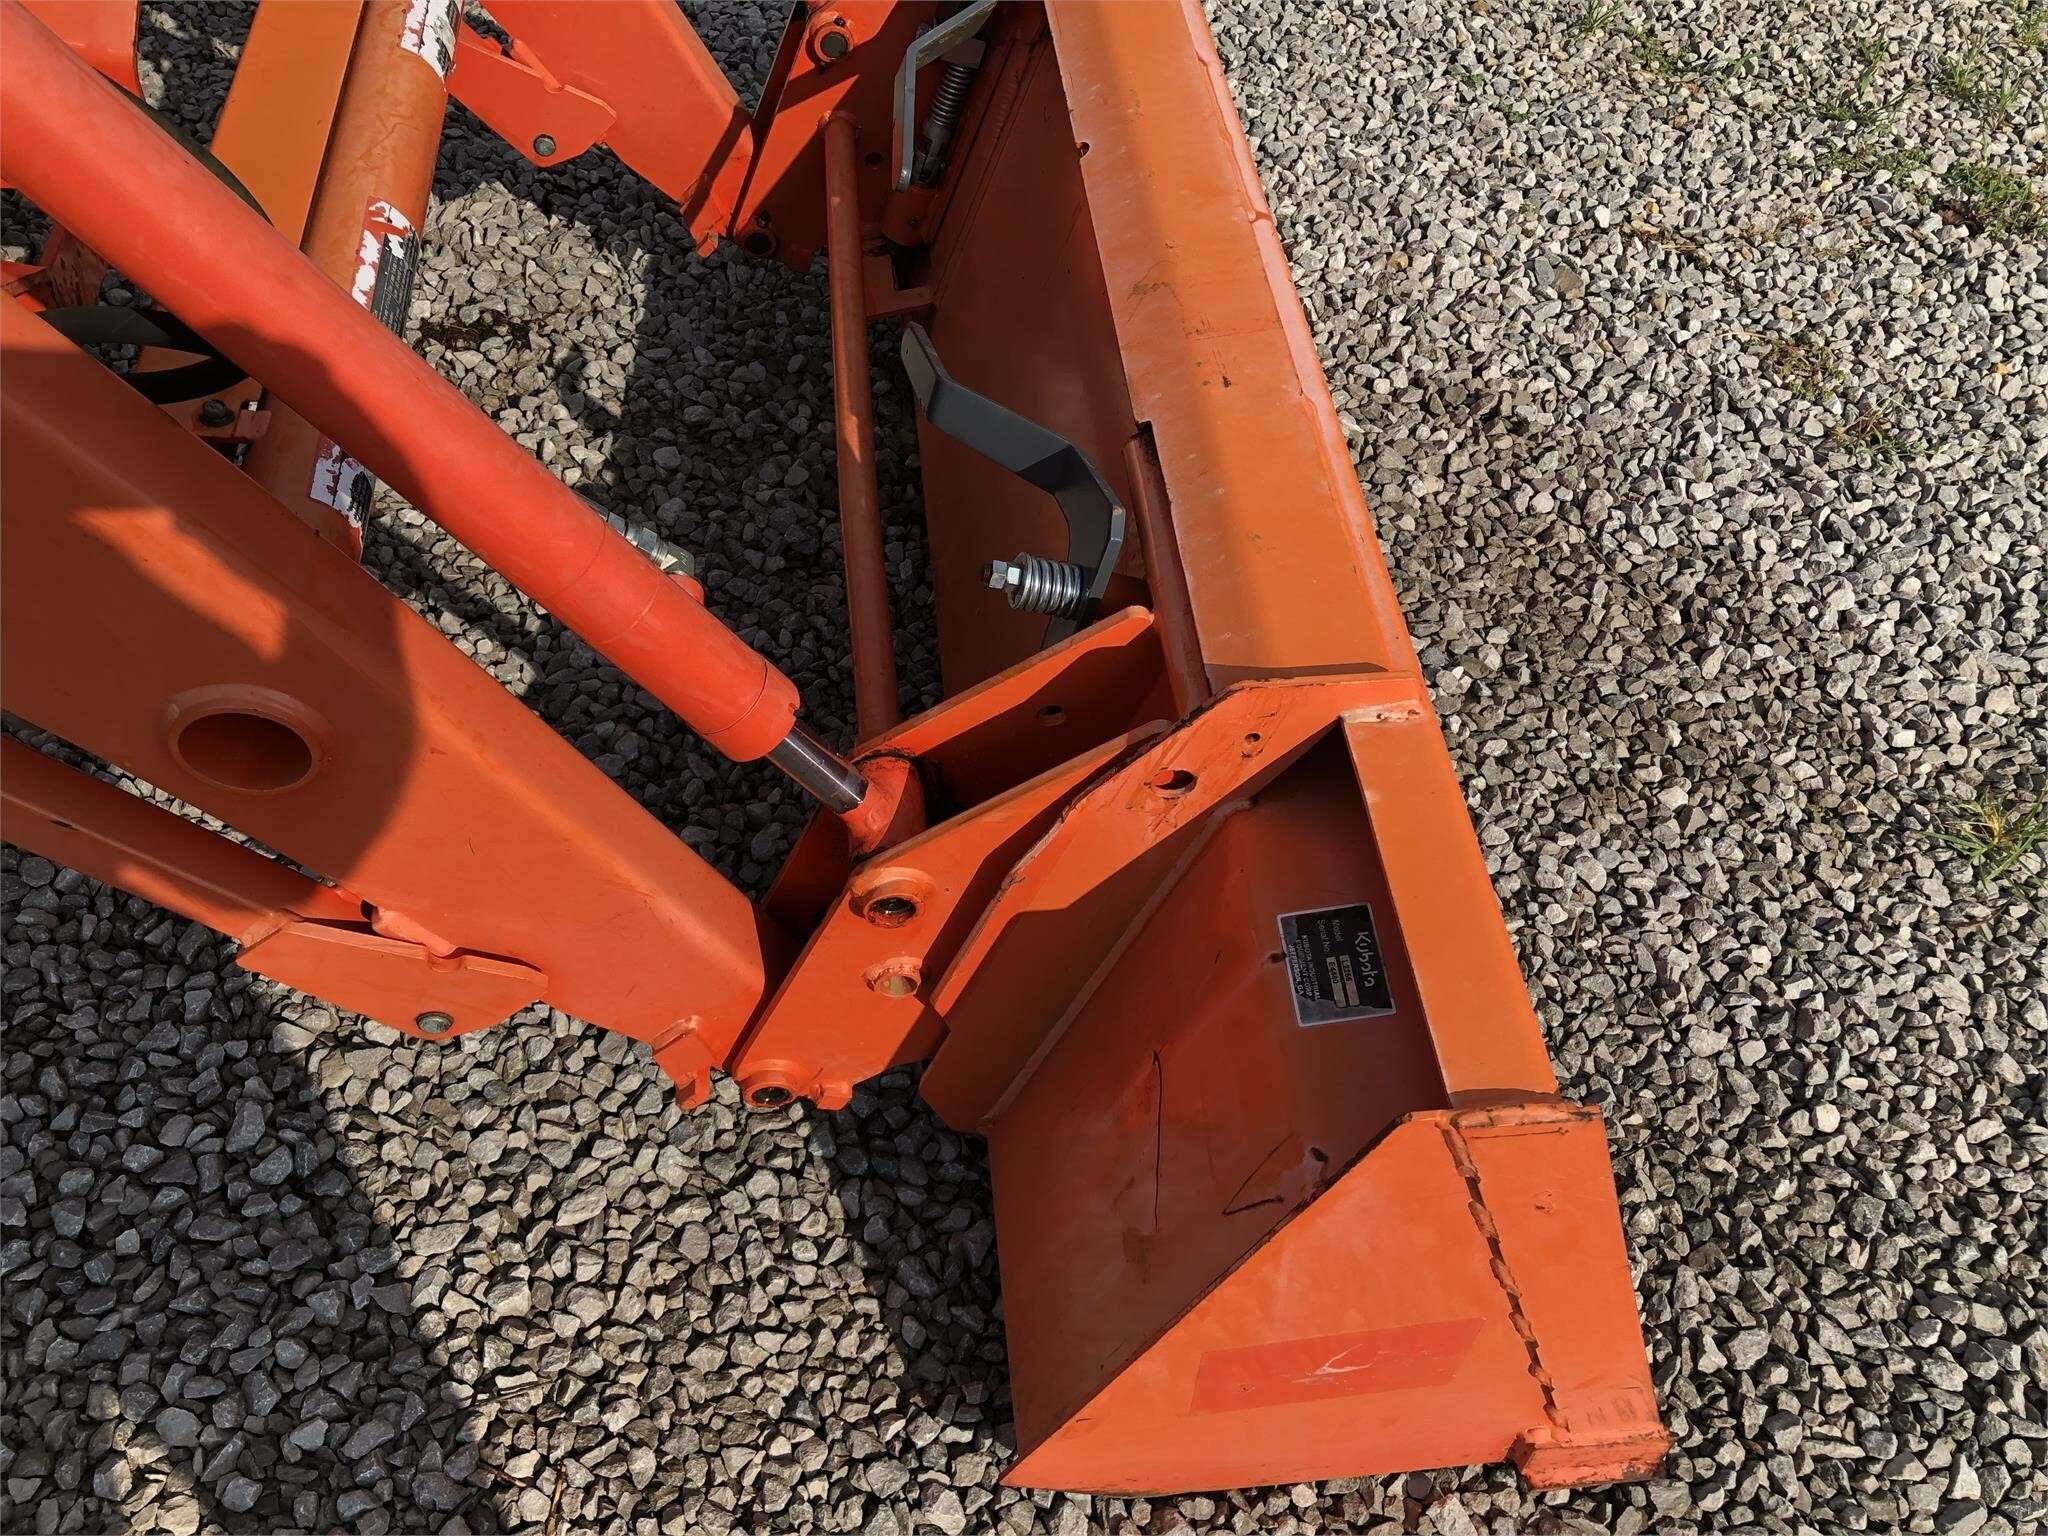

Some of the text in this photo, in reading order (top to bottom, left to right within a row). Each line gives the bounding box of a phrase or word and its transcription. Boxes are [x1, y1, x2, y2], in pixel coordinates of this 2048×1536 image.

[1318, 919, 1328, 940] Serial
[1333, 920, 1343, 941] Model
[1302, 935, 1320, 1000] KUBOTA INDUSTRIAL
[1355, 931, 1378, 987] Kubota
[1298, 985, 1304, 995] GA
